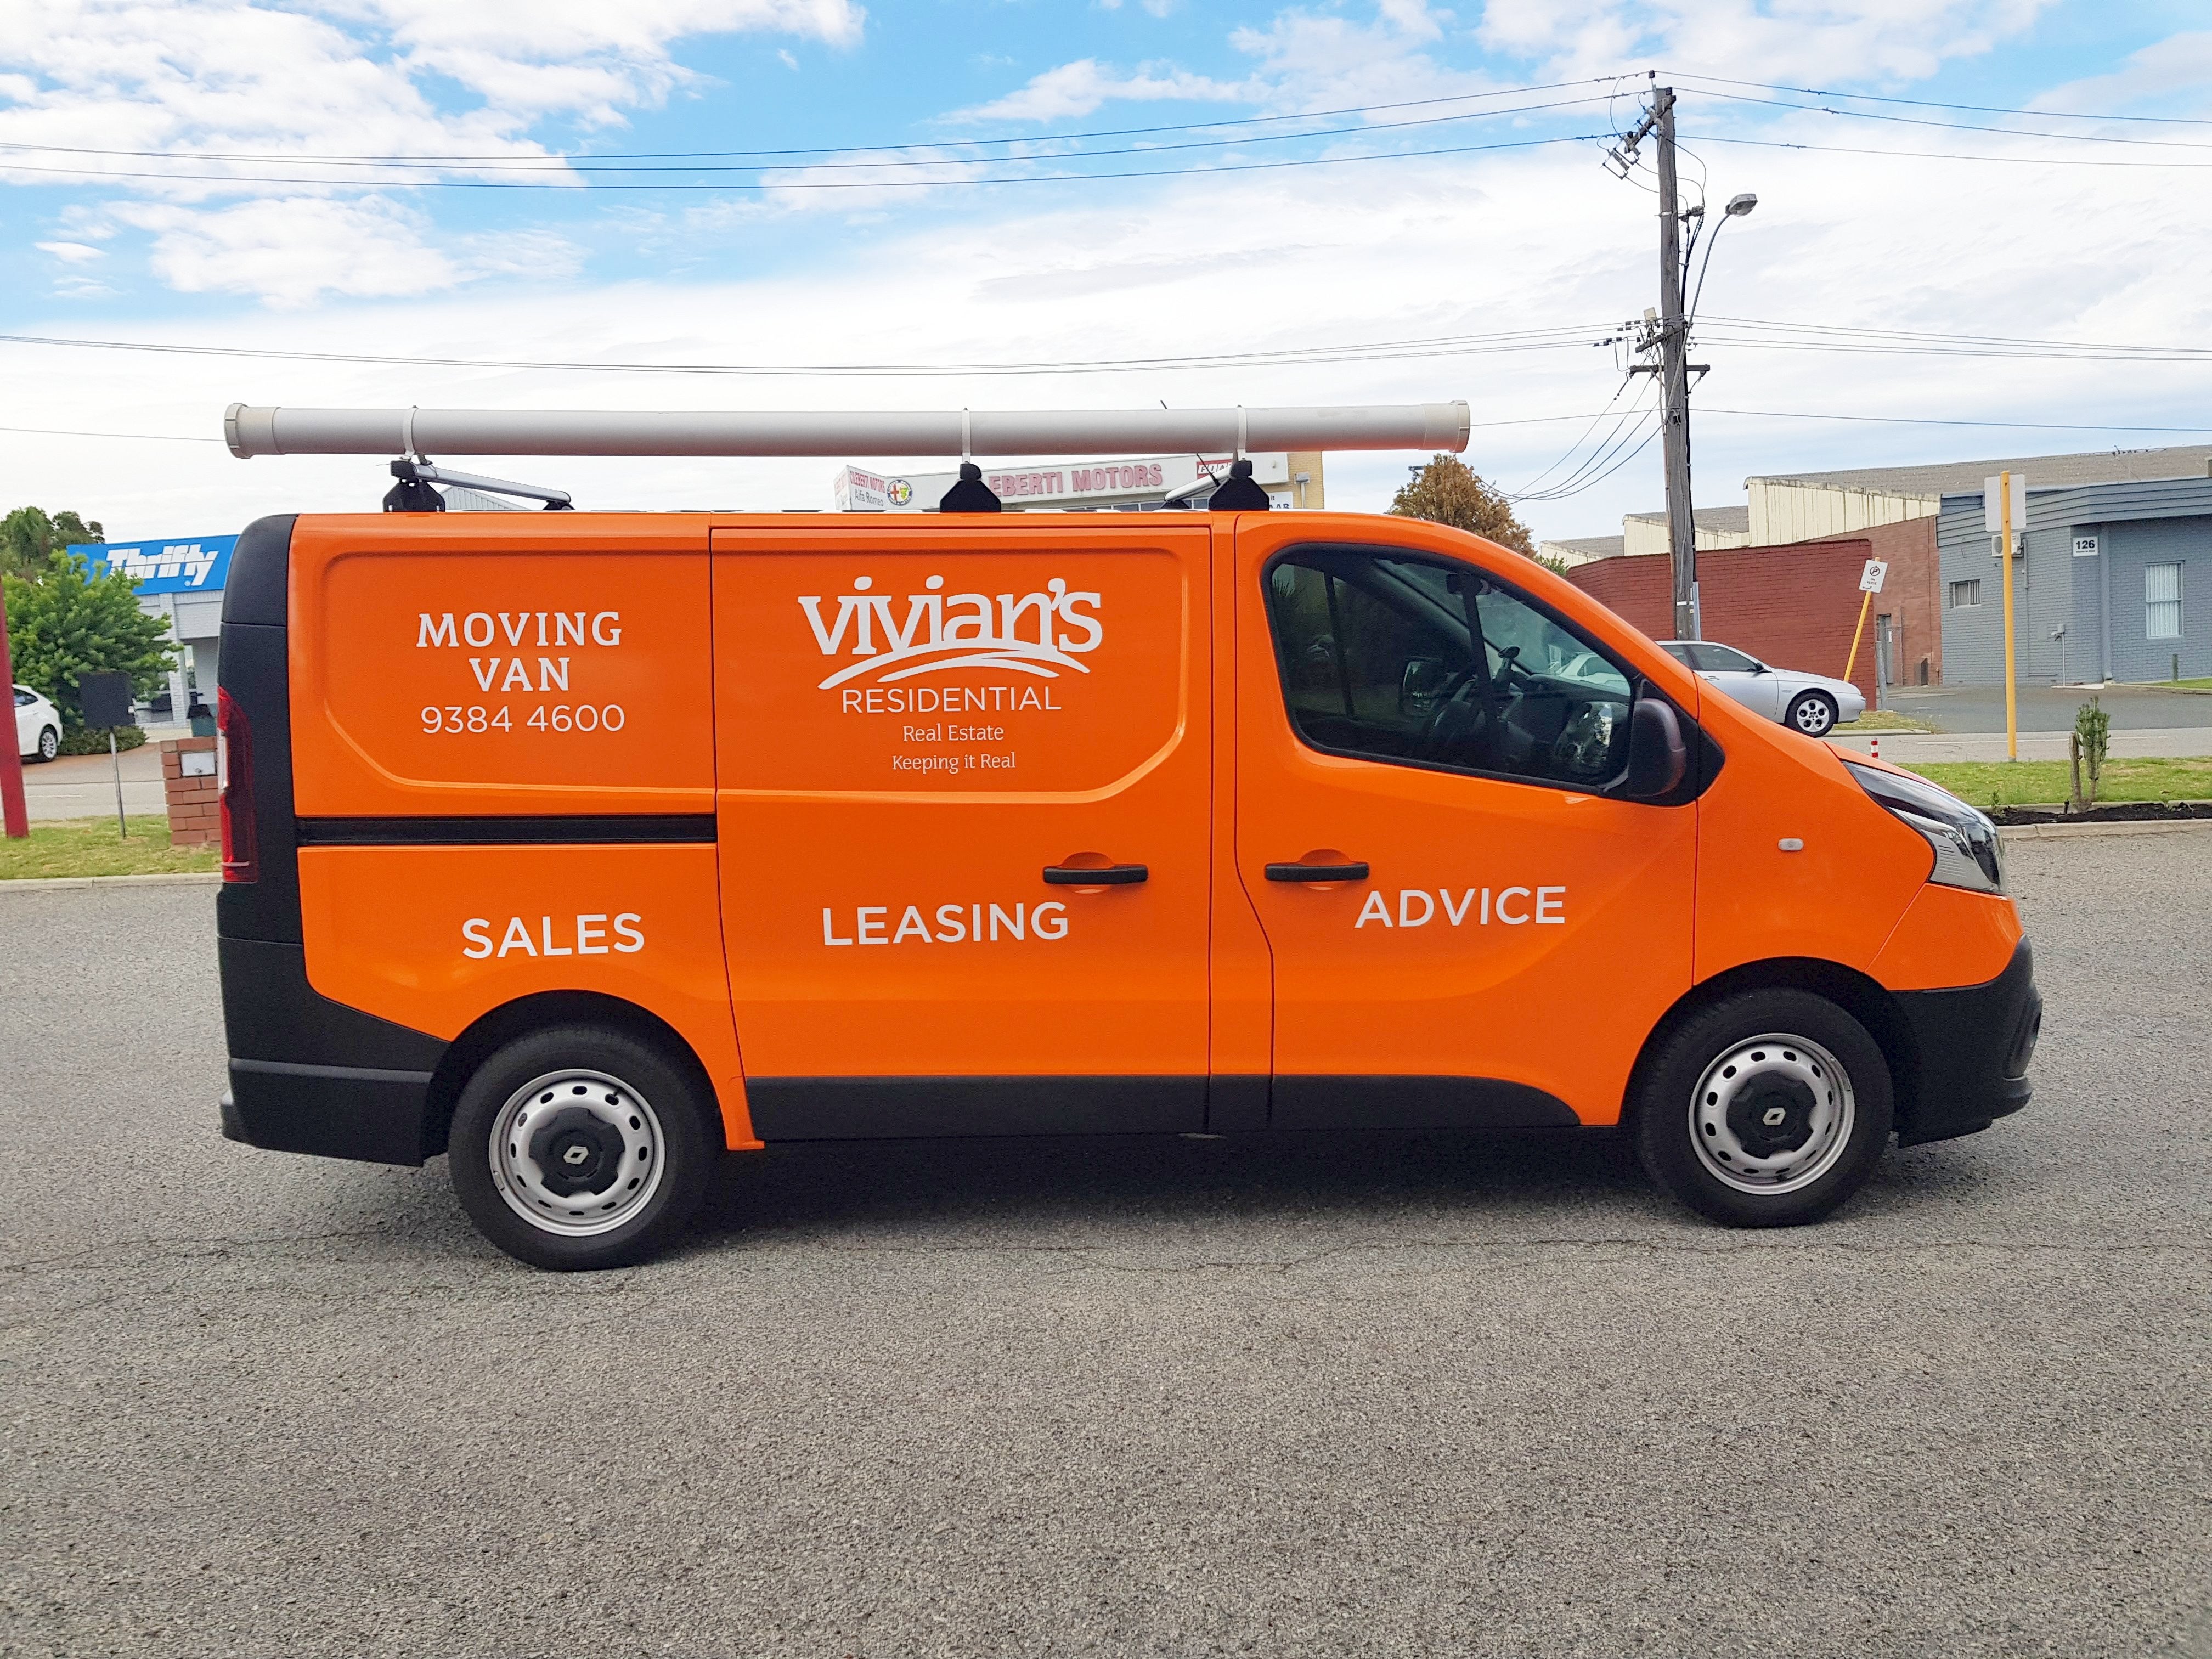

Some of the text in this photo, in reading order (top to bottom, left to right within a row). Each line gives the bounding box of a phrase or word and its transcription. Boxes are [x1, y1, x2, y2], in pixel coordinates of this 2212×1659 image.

[1071, 464, 1163, 492] MOTORS
[1201, 463, 1232, 472] FIA
[866, 492, 884, 506] Romeo
[2075, 539, 2095, 550] 126
[106, 544, 219, 586] Thrifty
[416, 611, 622, 647] MOVING
[469, 657, 570, 692] VAN
[843, 686, 1062, 713] RESIDENTIAL
[421, 704, 625, 733] 9384 4600
[903, 723, 1003, 742] Real Estate
[893, 752, 1015, 774] Keeping it Real
[1355, 886, 1566, 928] ADVICE
[462, 912, 645, 959] SALES
[823, 901, 1068, 946] LEASING
